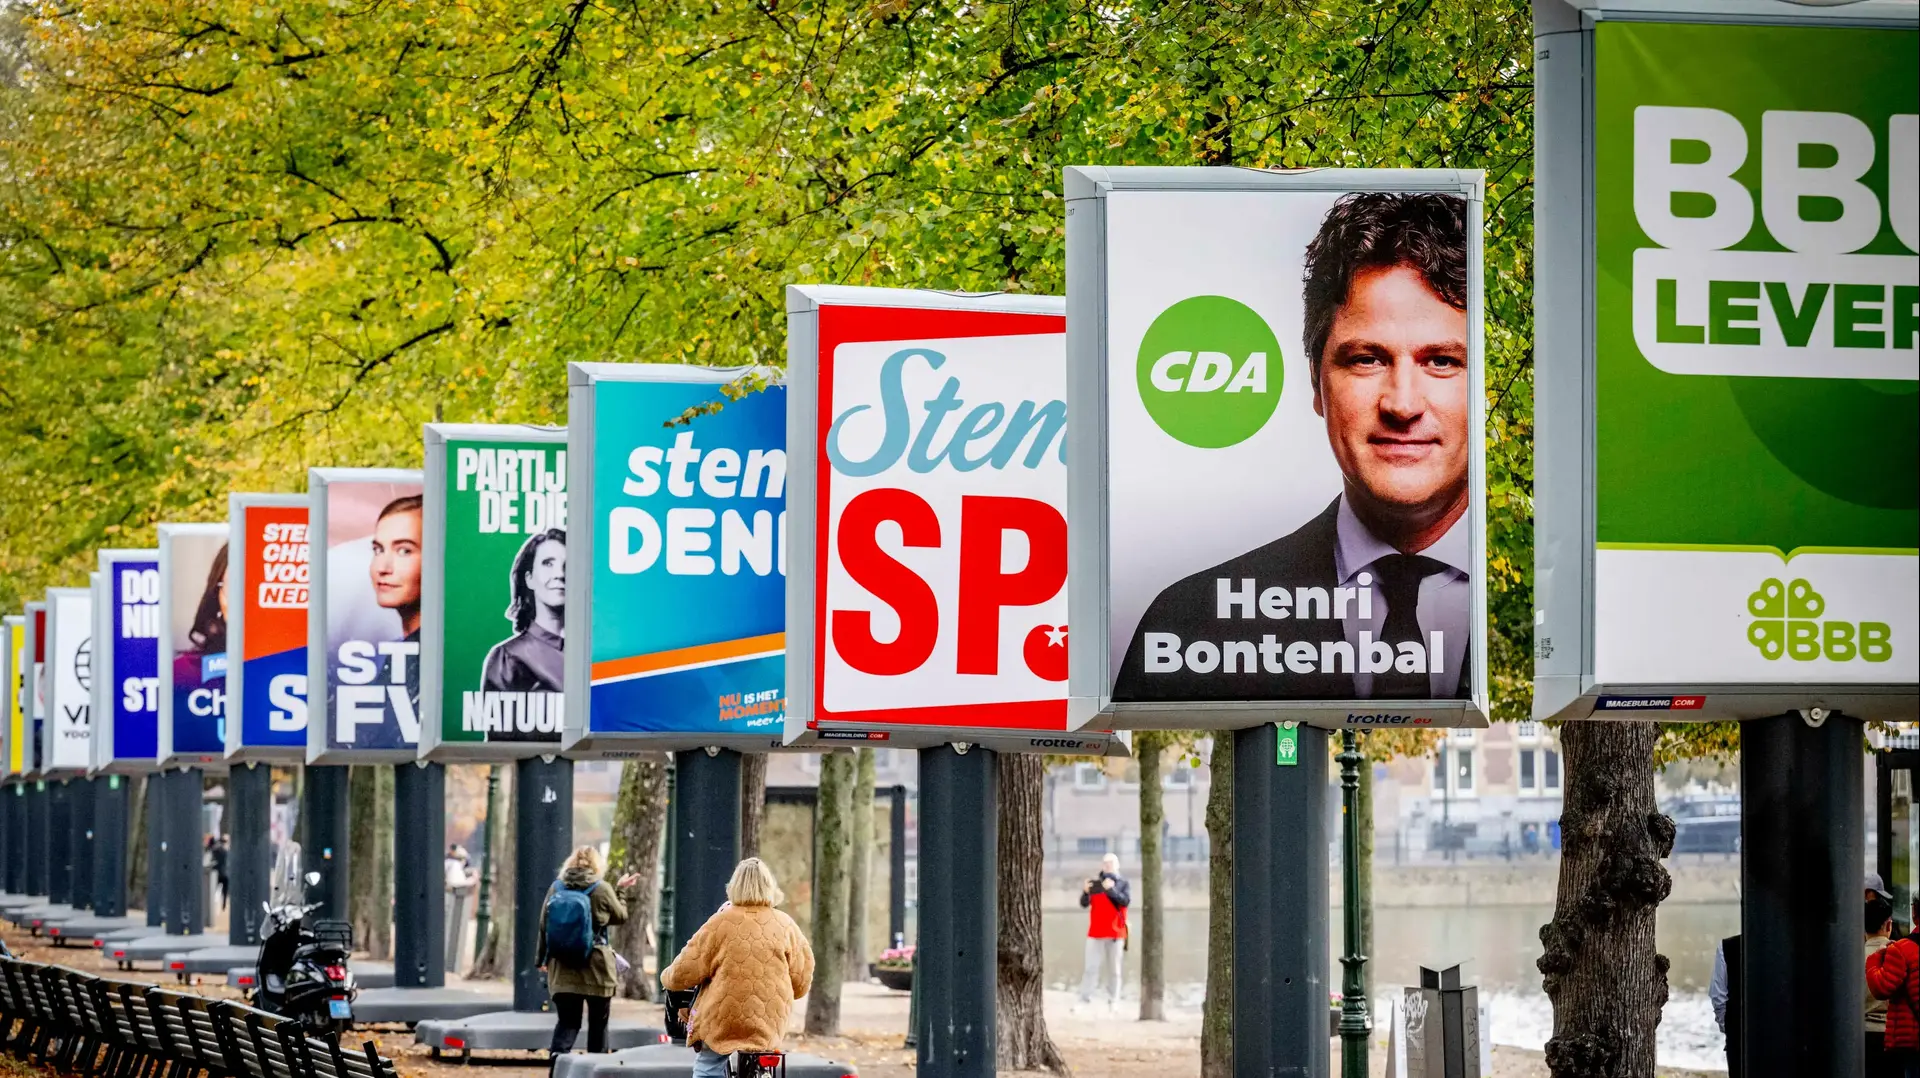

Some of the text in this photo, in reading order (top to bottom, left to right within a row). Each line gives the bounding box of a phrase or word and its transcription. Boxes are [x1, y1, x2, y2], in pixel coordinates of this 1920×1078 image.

[1633, 105, 1919, 254] BB
[1150, 351, 1267, 393] CDA
[457, 448, 567, 493] PARTIJ
[263, 523, 308, 542] STE
[479, 491, 519, 533] DE
[609, 506, 786, 576] DEN
[121, 569, 160, 604] DO
[264, 563, 309, 582] VOO
[1216, 572, 1372, 620] Henri
[337, 640, 419, 685] ST
[1144, 631, 1444, 675] Bontenbal
[1787, 621, 1893, 662] BBB
[719, 689, 779, 708] NU IS HET
